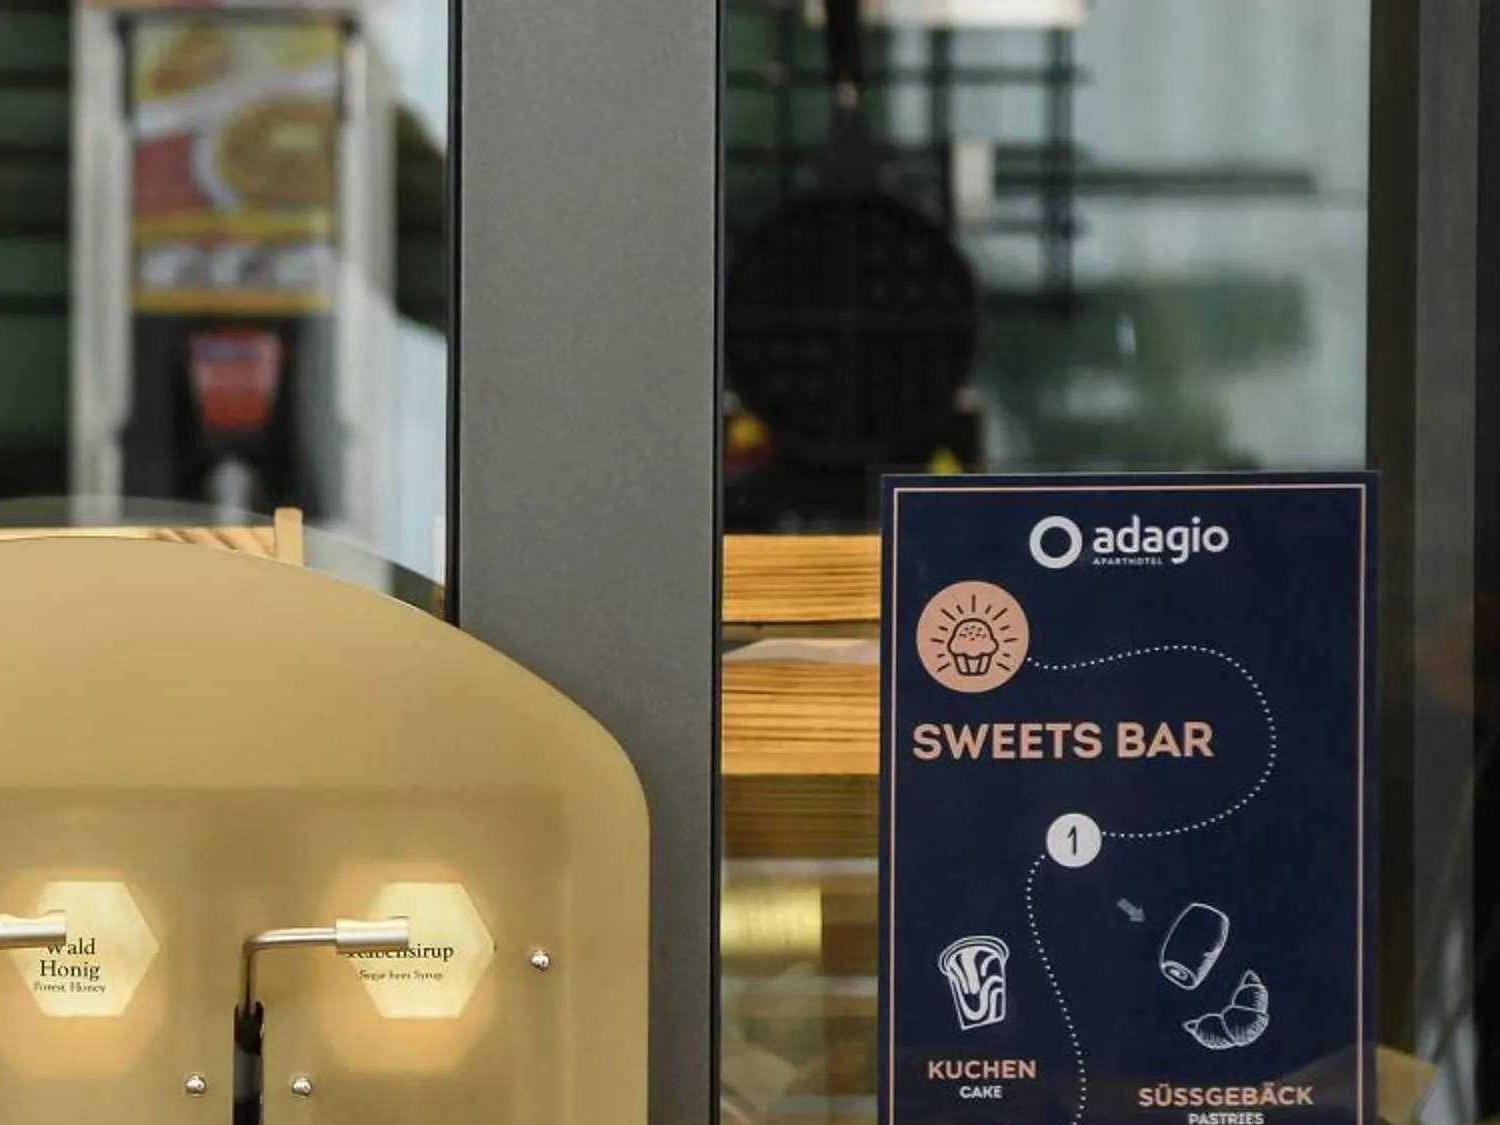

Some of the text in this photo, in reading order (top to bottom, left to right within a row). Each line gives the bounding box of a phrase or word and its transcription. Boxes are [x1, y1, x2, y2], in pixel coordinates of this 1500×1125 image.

[1092, 513, 1229, 565] adagio
[1092, 557, 1163, 566] APARTHOTEL
[912, 721, 1215, 760] SWEETS BAR
[1067, 825, 1078, 856] 1
[46, 937, 96, 956] Wald
[39, 959, 101, 981] Honig
[33, 981, 106, 994] Forest Honey
[927, 1060, 1037, 1081] KUCHEN
[959, 1085, 1003, 1100] CAKE
[1137, 1081, 1314, 1108] SÜSSGEBÄCK
